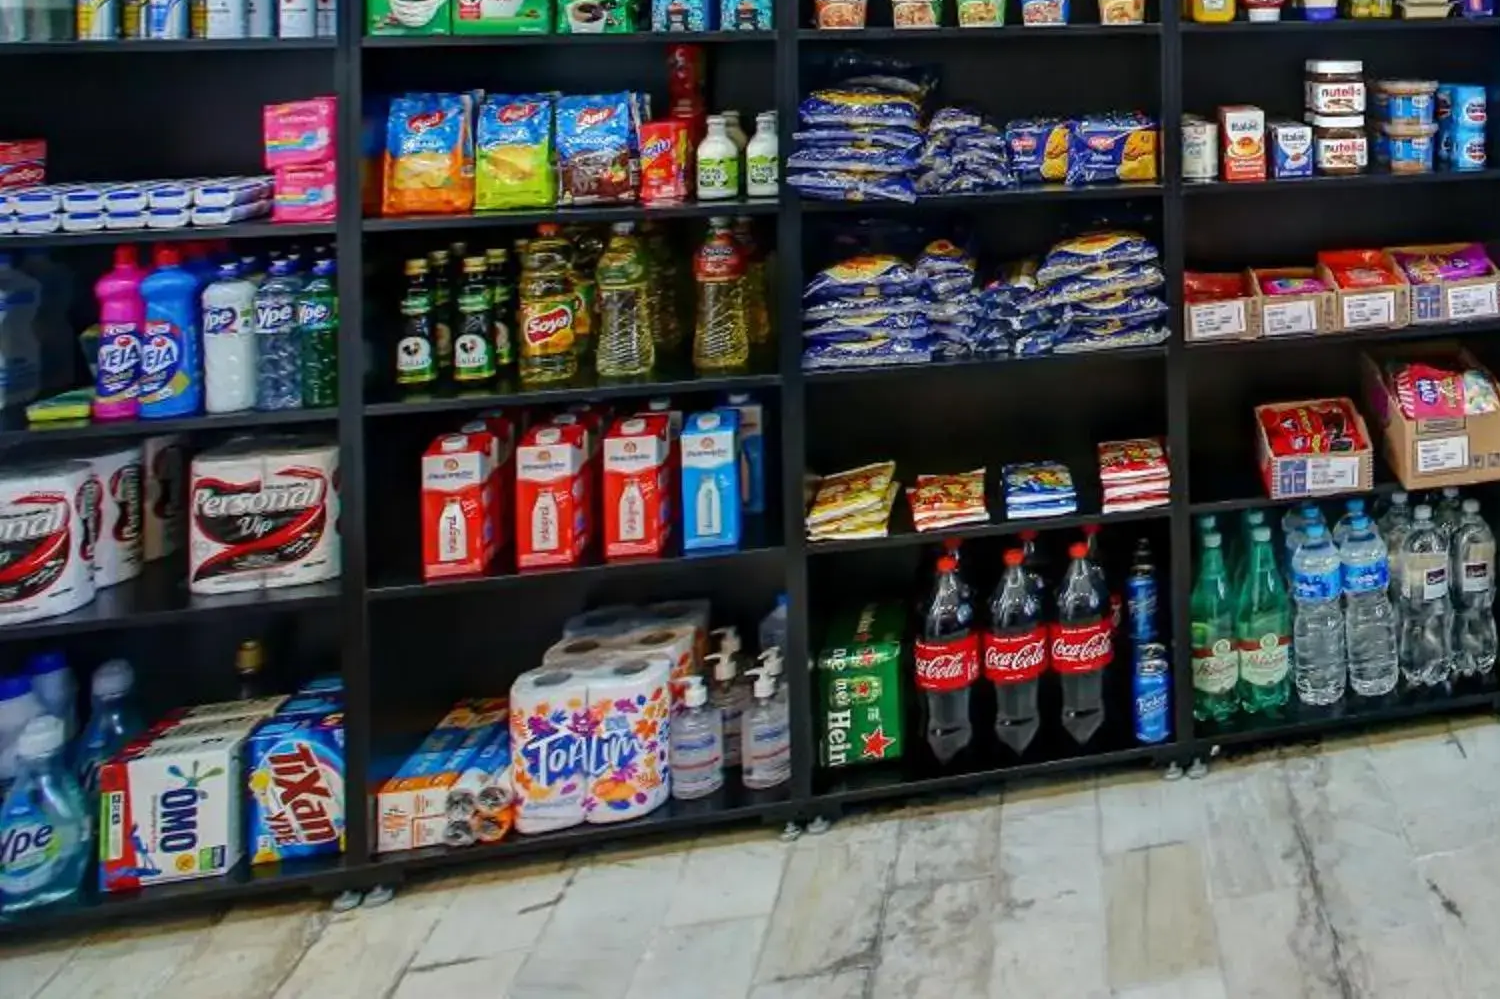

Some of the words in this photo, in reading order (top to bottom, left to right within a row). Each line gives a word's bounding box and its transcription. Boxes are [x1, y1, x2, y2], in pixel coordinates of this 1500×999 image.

[192, 481, 323, 517] Personal
[237, 517, 273, 537] Vip
[985, 639, 1045, 670] Coca-Cola
[1052, 630, 1112, 660] Coca-Cola
[159, 788, 199, 853] OMO
